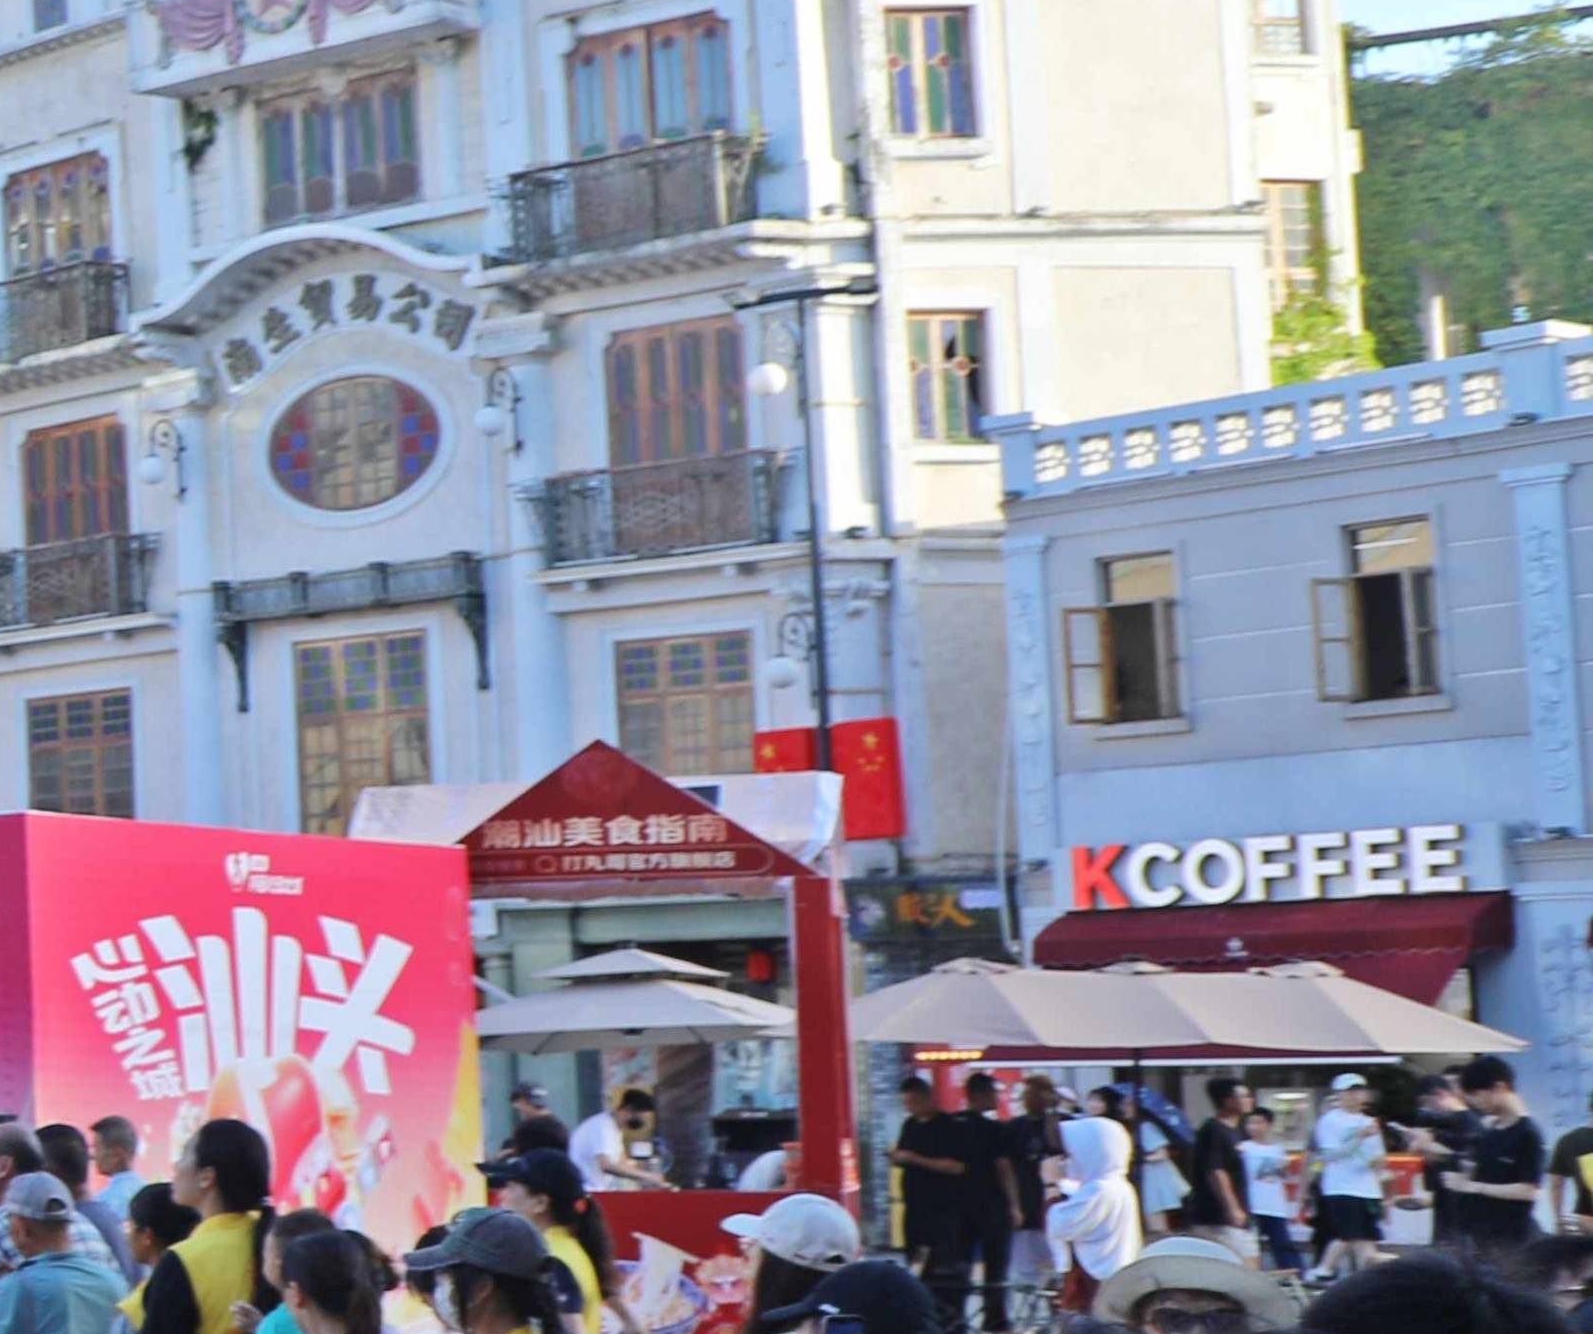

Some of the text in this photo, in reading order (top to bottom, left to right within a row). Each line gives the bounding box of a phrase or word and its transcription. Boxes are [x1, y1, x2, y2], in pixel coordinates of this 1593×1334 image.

[482, 813, 729, 850] 潮汕美食指南
[1070, 822, 1469, 910] KCOFFEE
[68, 932, 188, 1102] 心动之城
[138, 904, 416, 1097] 汕头
